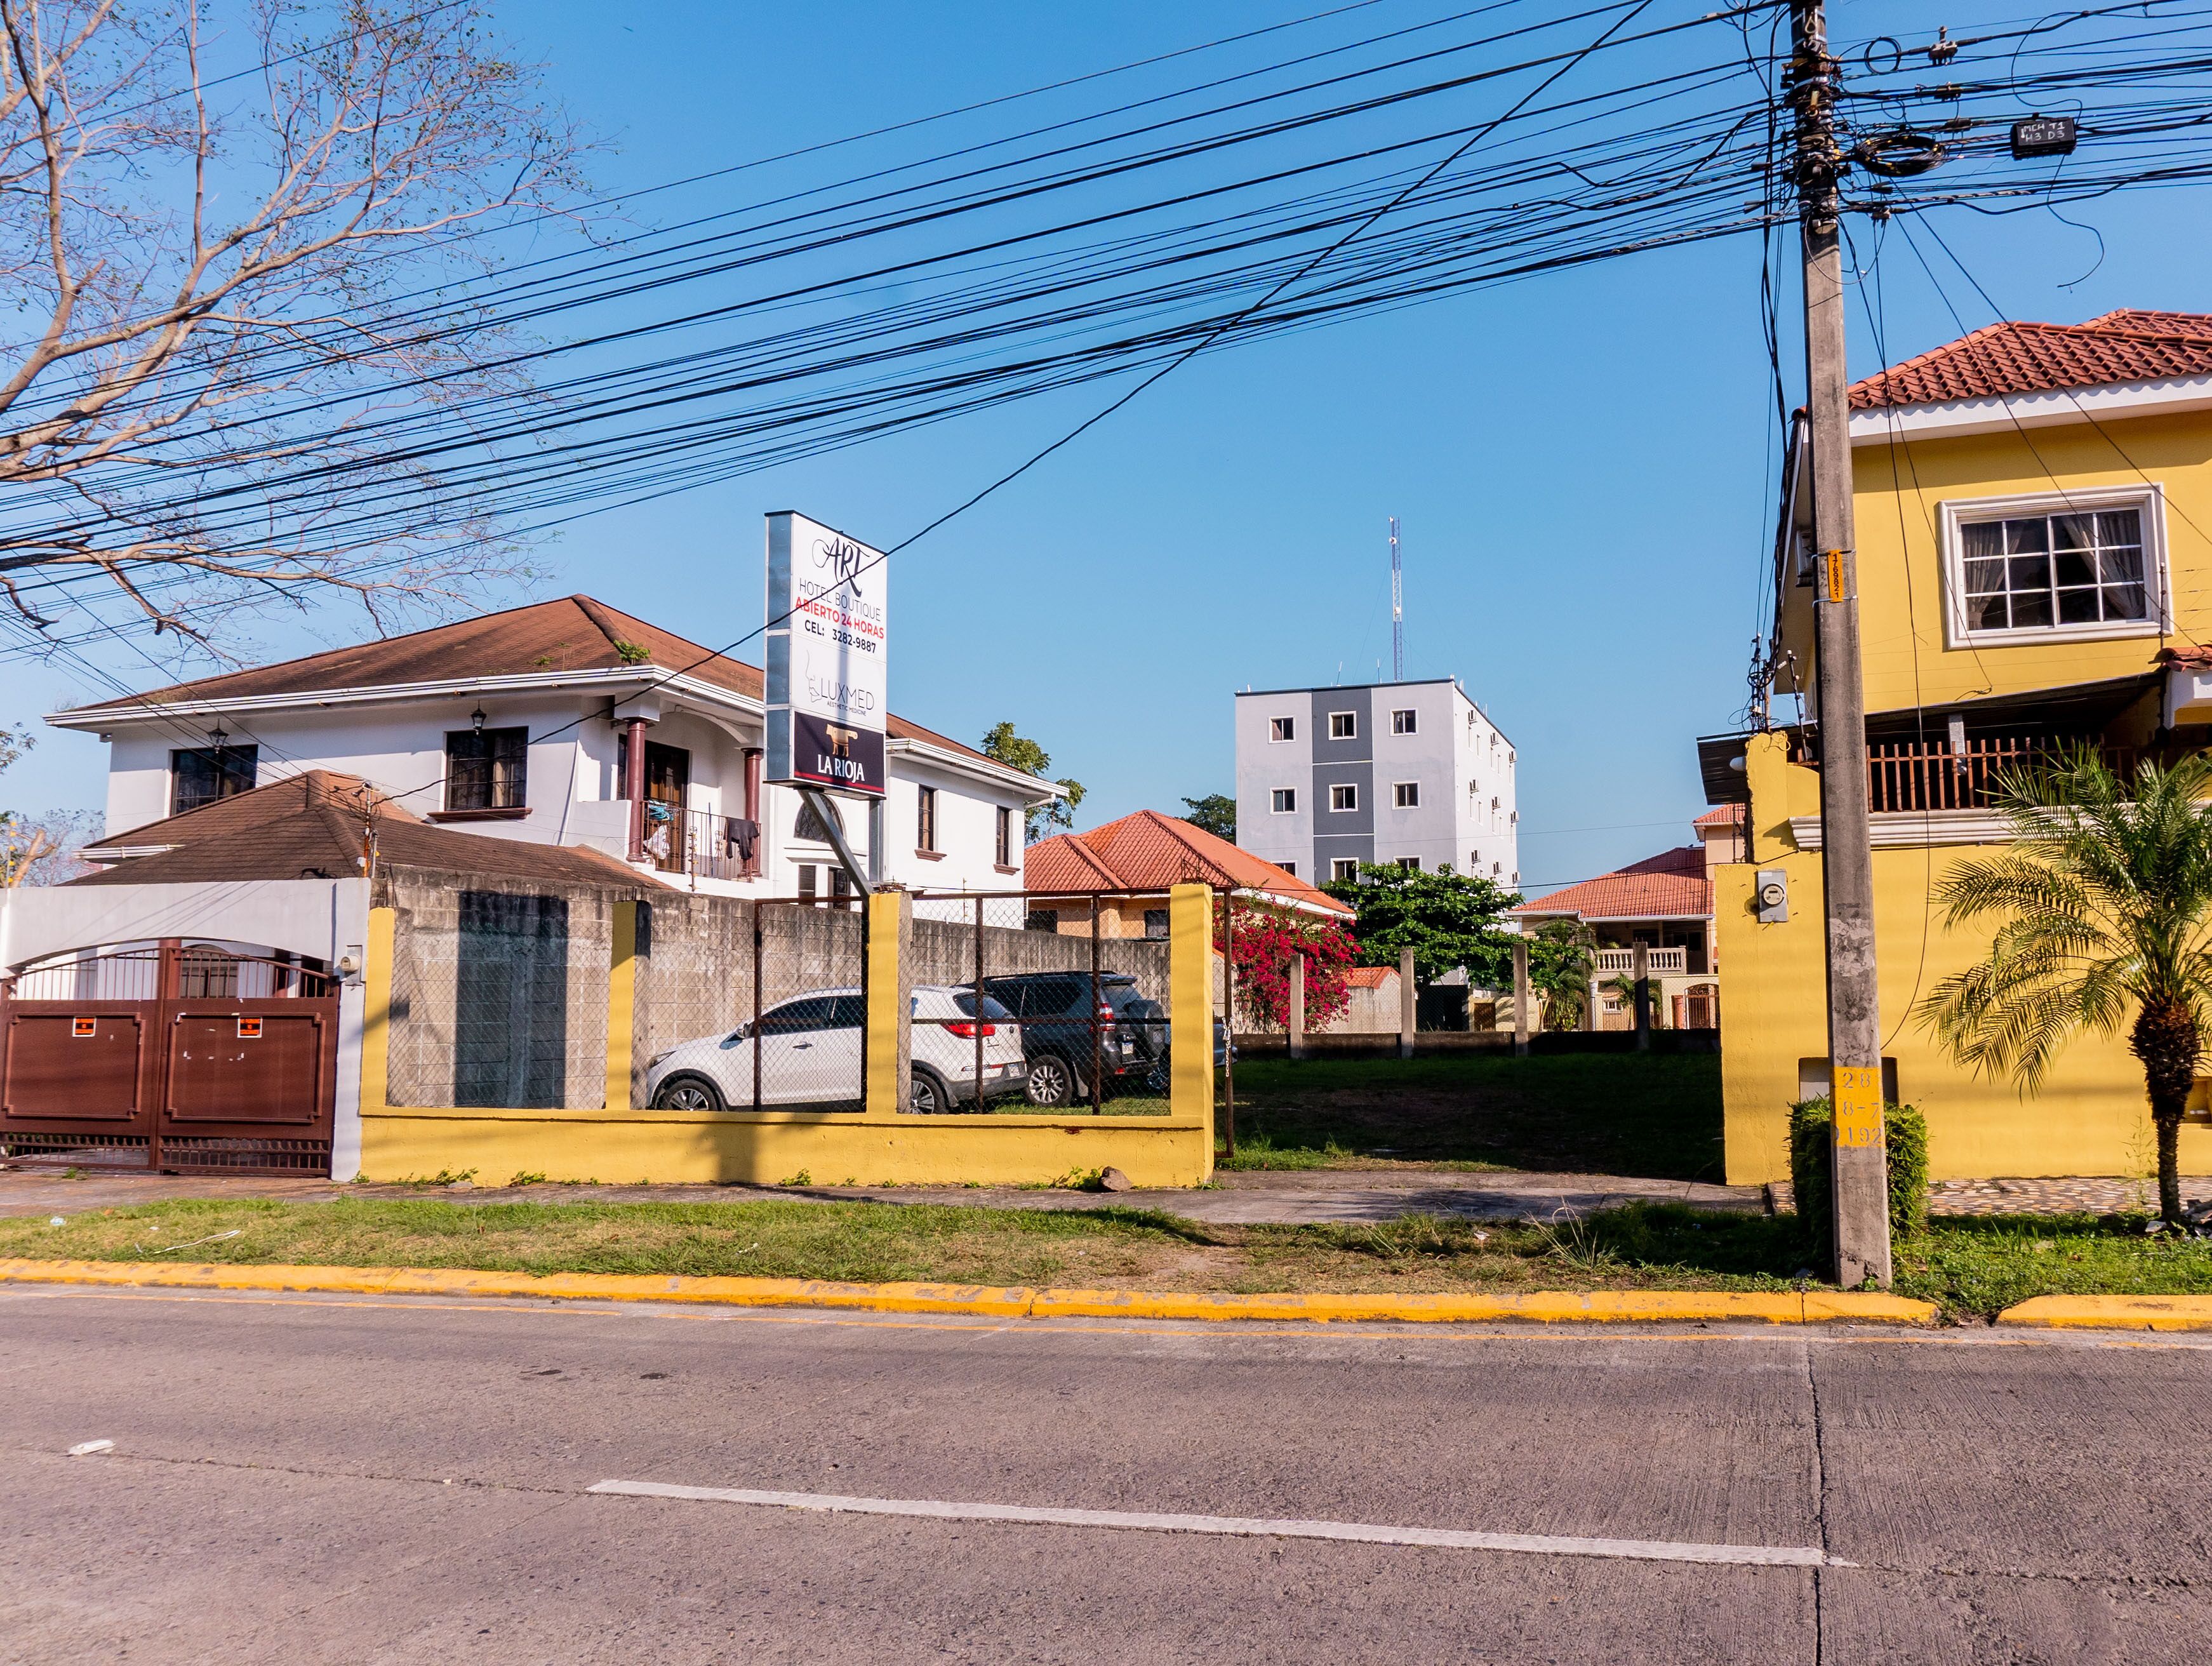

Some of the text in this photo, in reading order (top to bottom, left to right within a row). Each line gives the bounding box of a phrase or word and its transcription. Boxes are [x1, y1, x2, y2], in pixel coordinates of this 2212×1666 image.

[2048, 131, 2065, 140] D3
[812, 536, 870, 597] ART
[799, 578, 881, 622] HOTEL BOUTIQUE
[795, 596, 884, 639] ABIERTO 24 HORAS
[804, 619, 876, 653] CEL: 3282-9887
[821, 677, 875, 710] LUXMED
[818, 754, 865, 783] LA RIOJA
